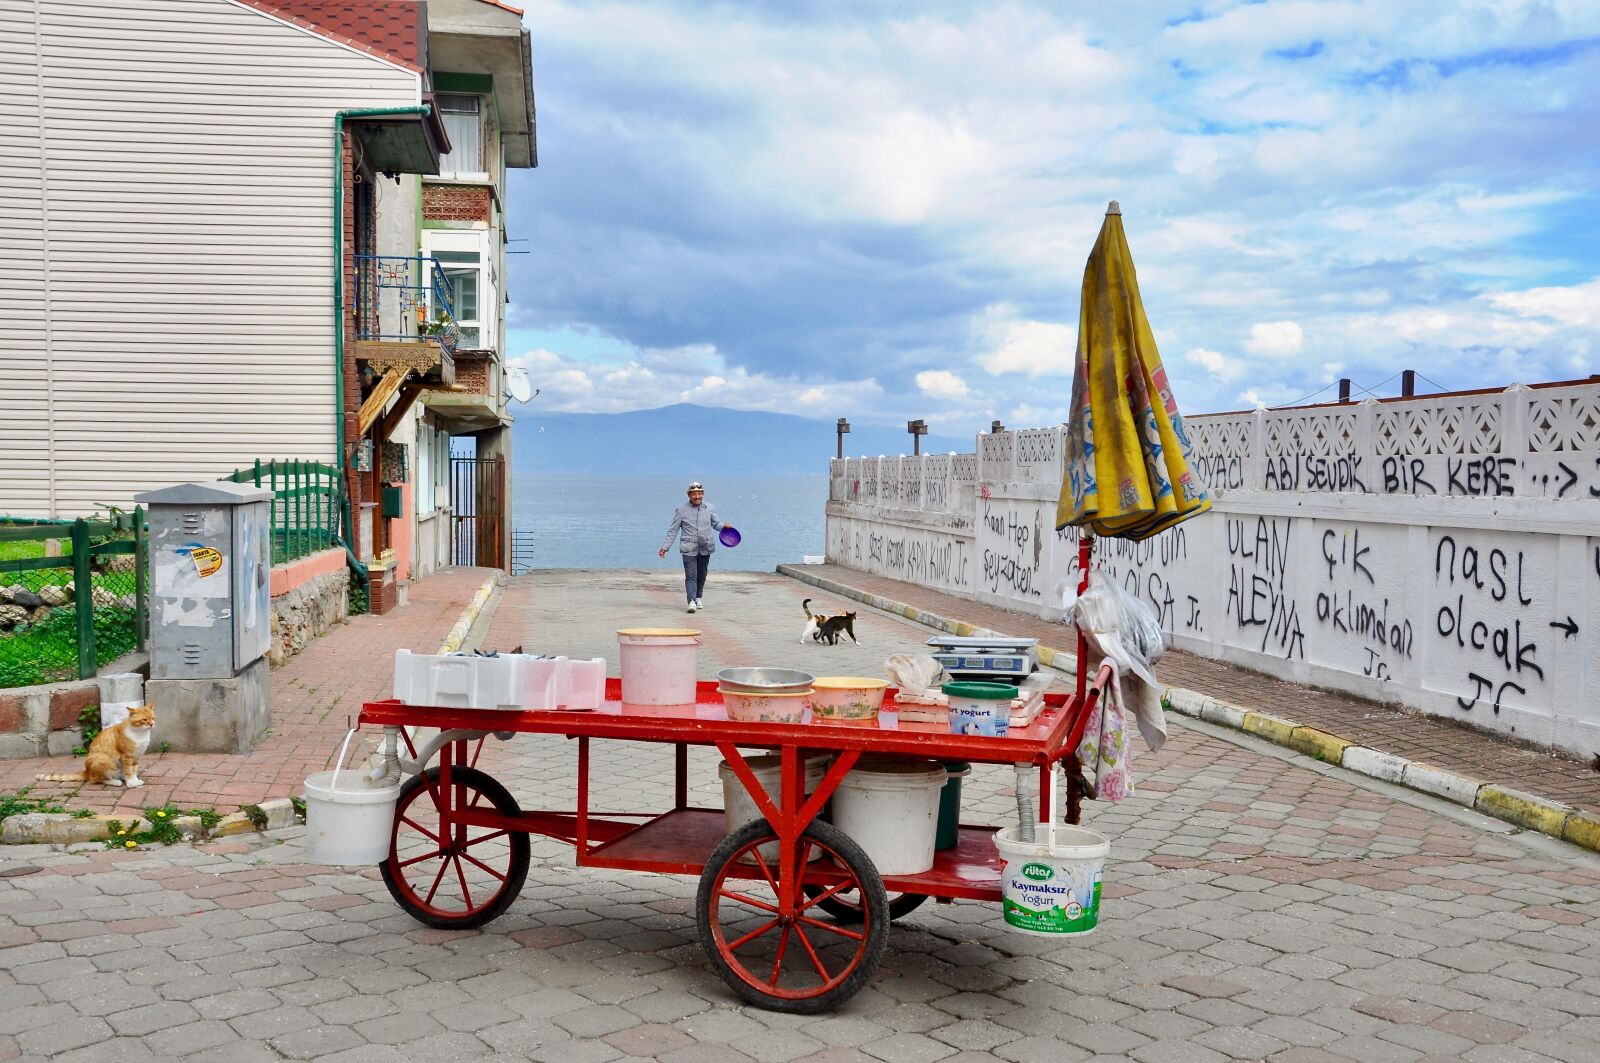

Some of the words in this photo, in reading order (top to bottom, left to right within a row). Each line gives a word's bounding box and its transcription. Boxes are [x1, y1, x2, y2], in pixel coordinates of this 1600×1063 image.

[1382, 454, 1437, 494] BİR
[1447, 455, 1517, 496] KERE
[1228, 516, 1291, 590] ULAN
[1227, 564, 1304, 659] ALEYNA
[1012, 880, 1066, 894] Kaymaksız
[1021, 893, 1054, 906] Yoğurt
